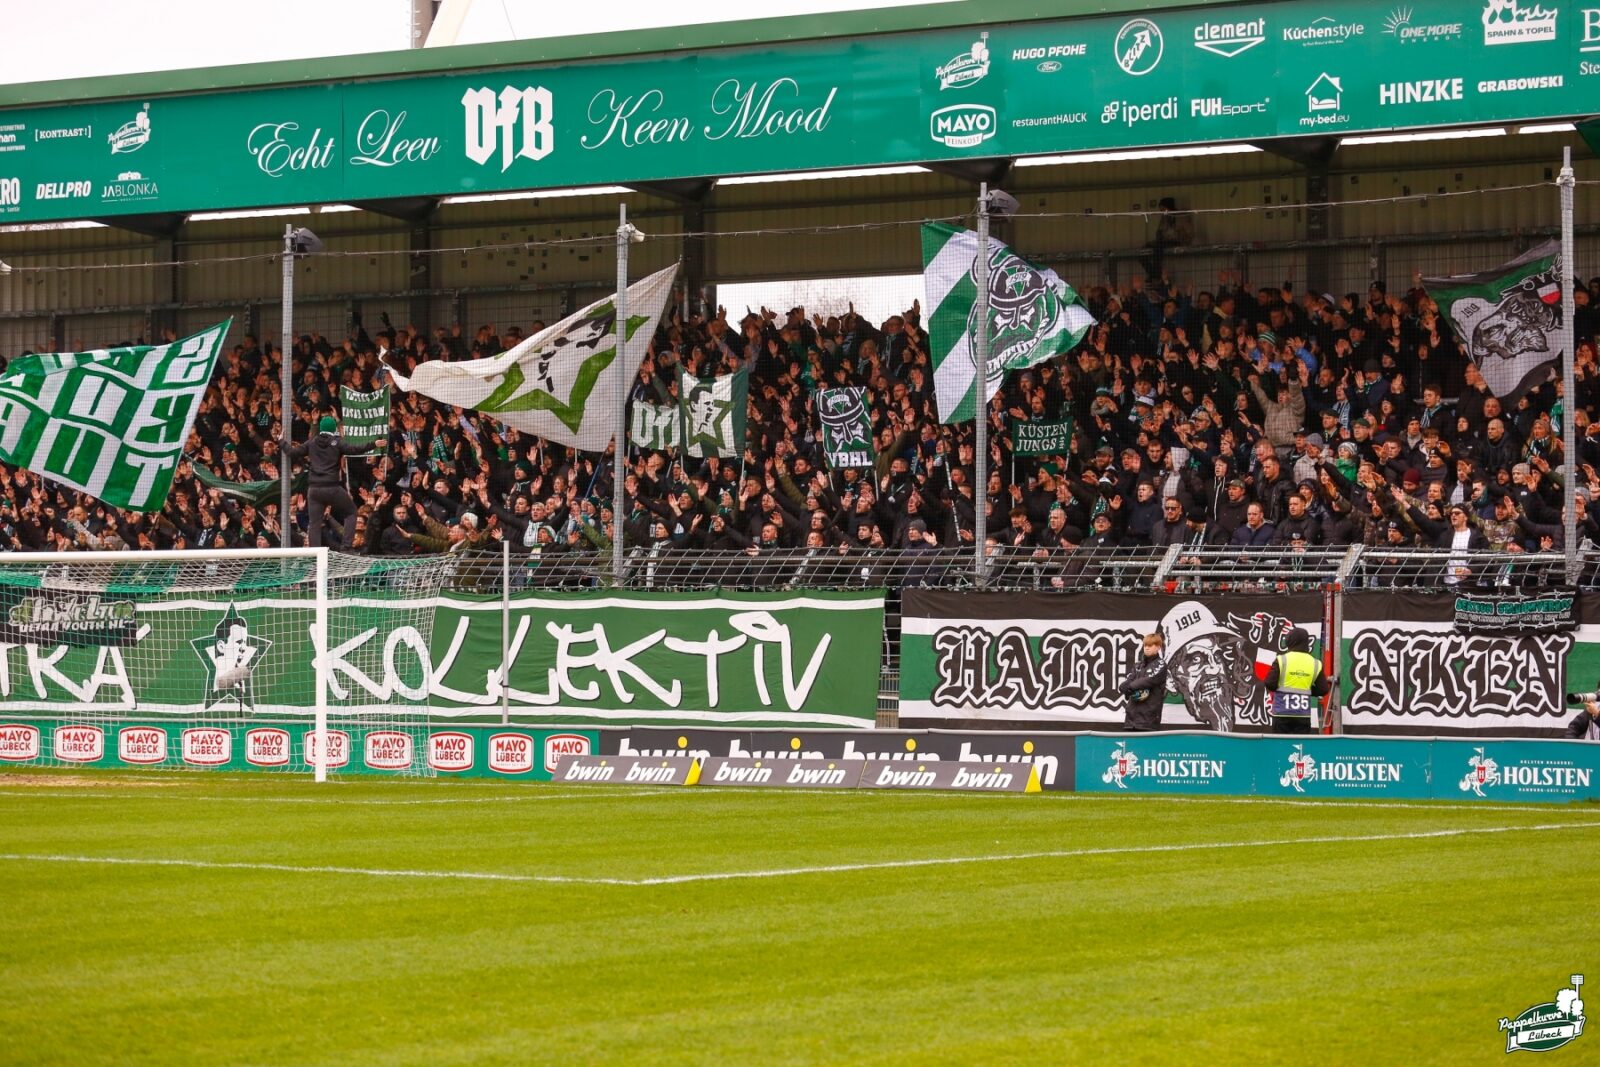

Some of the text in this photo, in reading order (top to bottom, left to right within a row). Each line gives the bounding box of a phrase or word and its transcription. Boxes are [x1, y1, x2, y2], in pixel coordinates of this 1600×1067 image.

[1194, 18, 1266, 40] clement
[1283, 23, 1364, 40] Küchenstyle
[1400, 23, 1462, 38] ONE MORE
[1487, 30, 1516, 38] SPAHN
[1525, 26, 1554, 35] TOPEL
[1012, 44, 1086, 60] HUGO PFOHE
[1123, 34, 1146, 68] BLITZ
[1379, 78, 1463, 105] HINZKE
[1477, 75, 1563, 93] GRABOWSKI
[1012, 112, 1087, 128] restaurantHAUCK
[1122, 97, 1178, 127] iperdi
[1300, 113, 1349, 127] my-bed.eu
[247, 121, 336, 178] Echt
[350, 109, 442, 167] Leev
[580, 88, 694, 150] Keen
[703, 77, 838, 140] Mood
[937, 112, 990, 134] MAYO
[36, 181, 91, 200] DELLPRO
[101, 182, 159, 198] JABLONKA
[1461, 303, 1481, 318] 1919
[1018, 422, 1068, 438] KÜSTEN
[1016, 438, 1057, 452] JUNGS
[828, 451, 873, 468] VBHL
[20, 619, 126, 633] ULTRA YOUTH HL
[1175, 610, 1202, 631] 1919
[310, 611, 831, 711] KOLLEKTIV
[1283, 694, 1309, 710] 135
[62, 731, 96, 743] MAYO
[127, 733, 159, 744] MAYO
[190, 734, 223, 745] MAYO
[253, 735, 283, 746] MAYO
[372, 738, 405, 749] MAYO
[435, 738, 466, 750] MAYO
[62, 742, 95, 752] LÜBECK
[127, 743, 158, 754] LÜBECK
[190, 745, 223, 755] LÜBECK
[253, 746, 282, 756] LÜBECK
[372, 749, 404, 759] LÜBECK
[496, 740, 526, 752] MAYO
[552, 741, 583, 754] MAYO
[435, 749, 465, 760] LÜBECK
[496, 752, 526, 762] LÜBECK
[564, 761, 615, 780] bwin
[625, 761, 677, 781] bwin
[714, 762, 773, 783] bwin
[787, 764, 846, 784] bwin
[876, 765, 937, 786] bwin
[1144, 759, 1223, 778] HOLSTEN
[1321, 762, 1400, 782] HOLSTEN
[1504, 766, 1590, 787] HOLSTEN
[951, 767, 1013, 788] bwin
